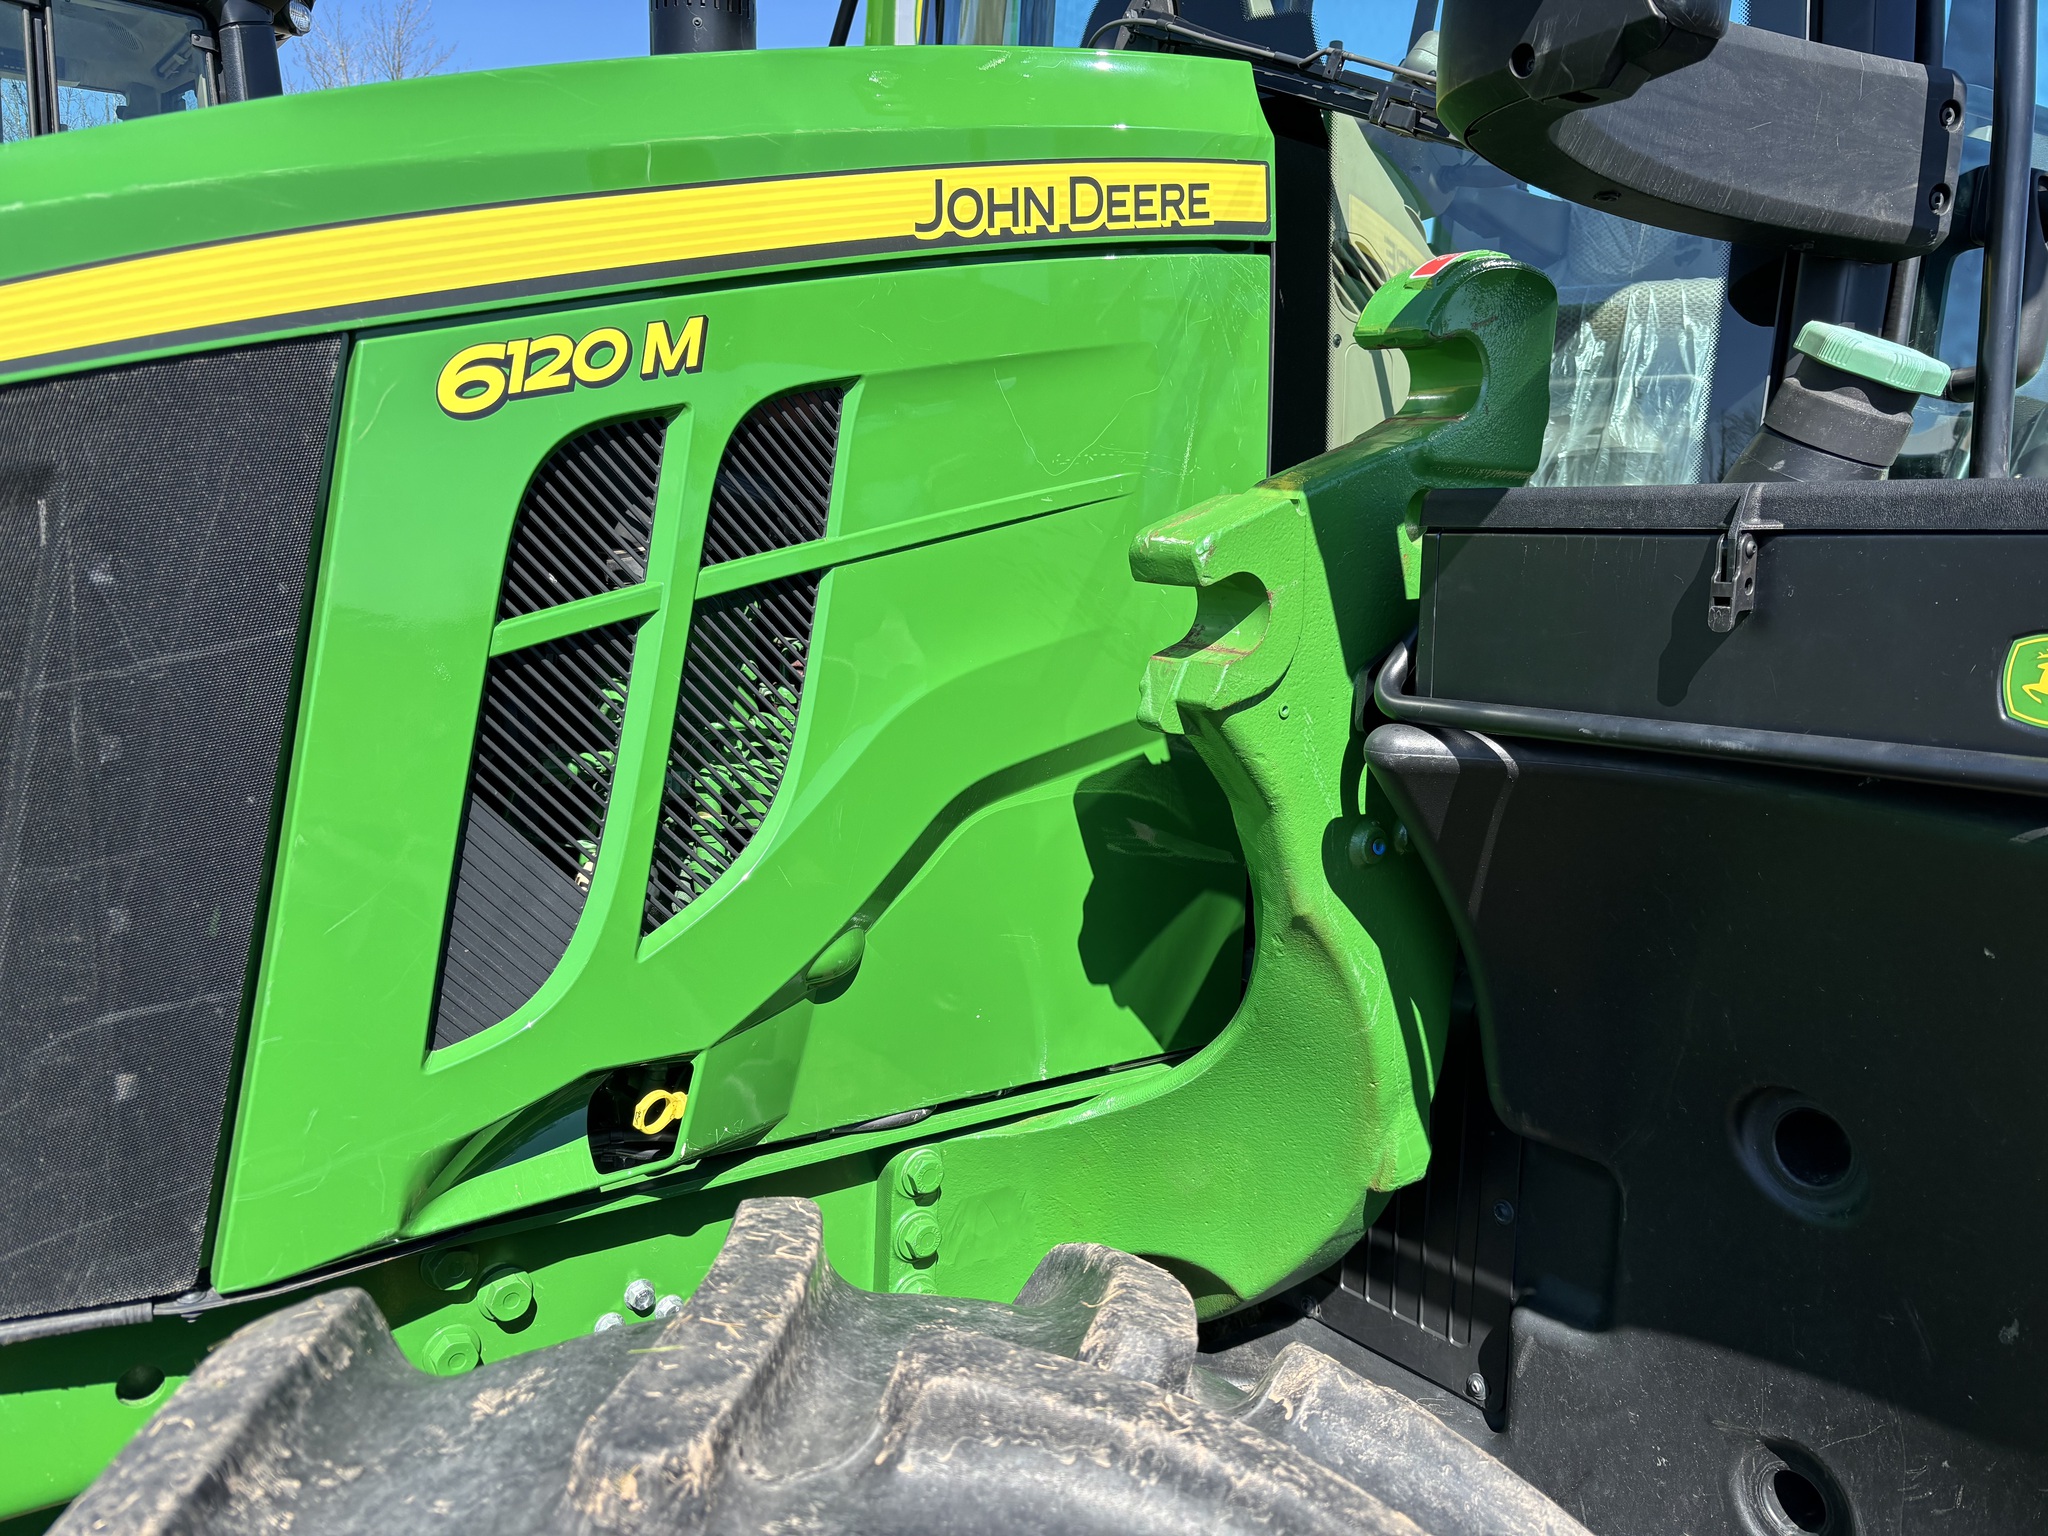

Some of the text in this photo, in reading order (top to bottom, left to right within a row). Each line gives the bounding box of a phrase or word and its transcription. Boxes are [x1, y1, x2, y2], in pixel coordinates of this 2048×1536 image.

[914, 175, 1211, 233] JOHN DEERE
[437, 327, 632, 420] 6120
